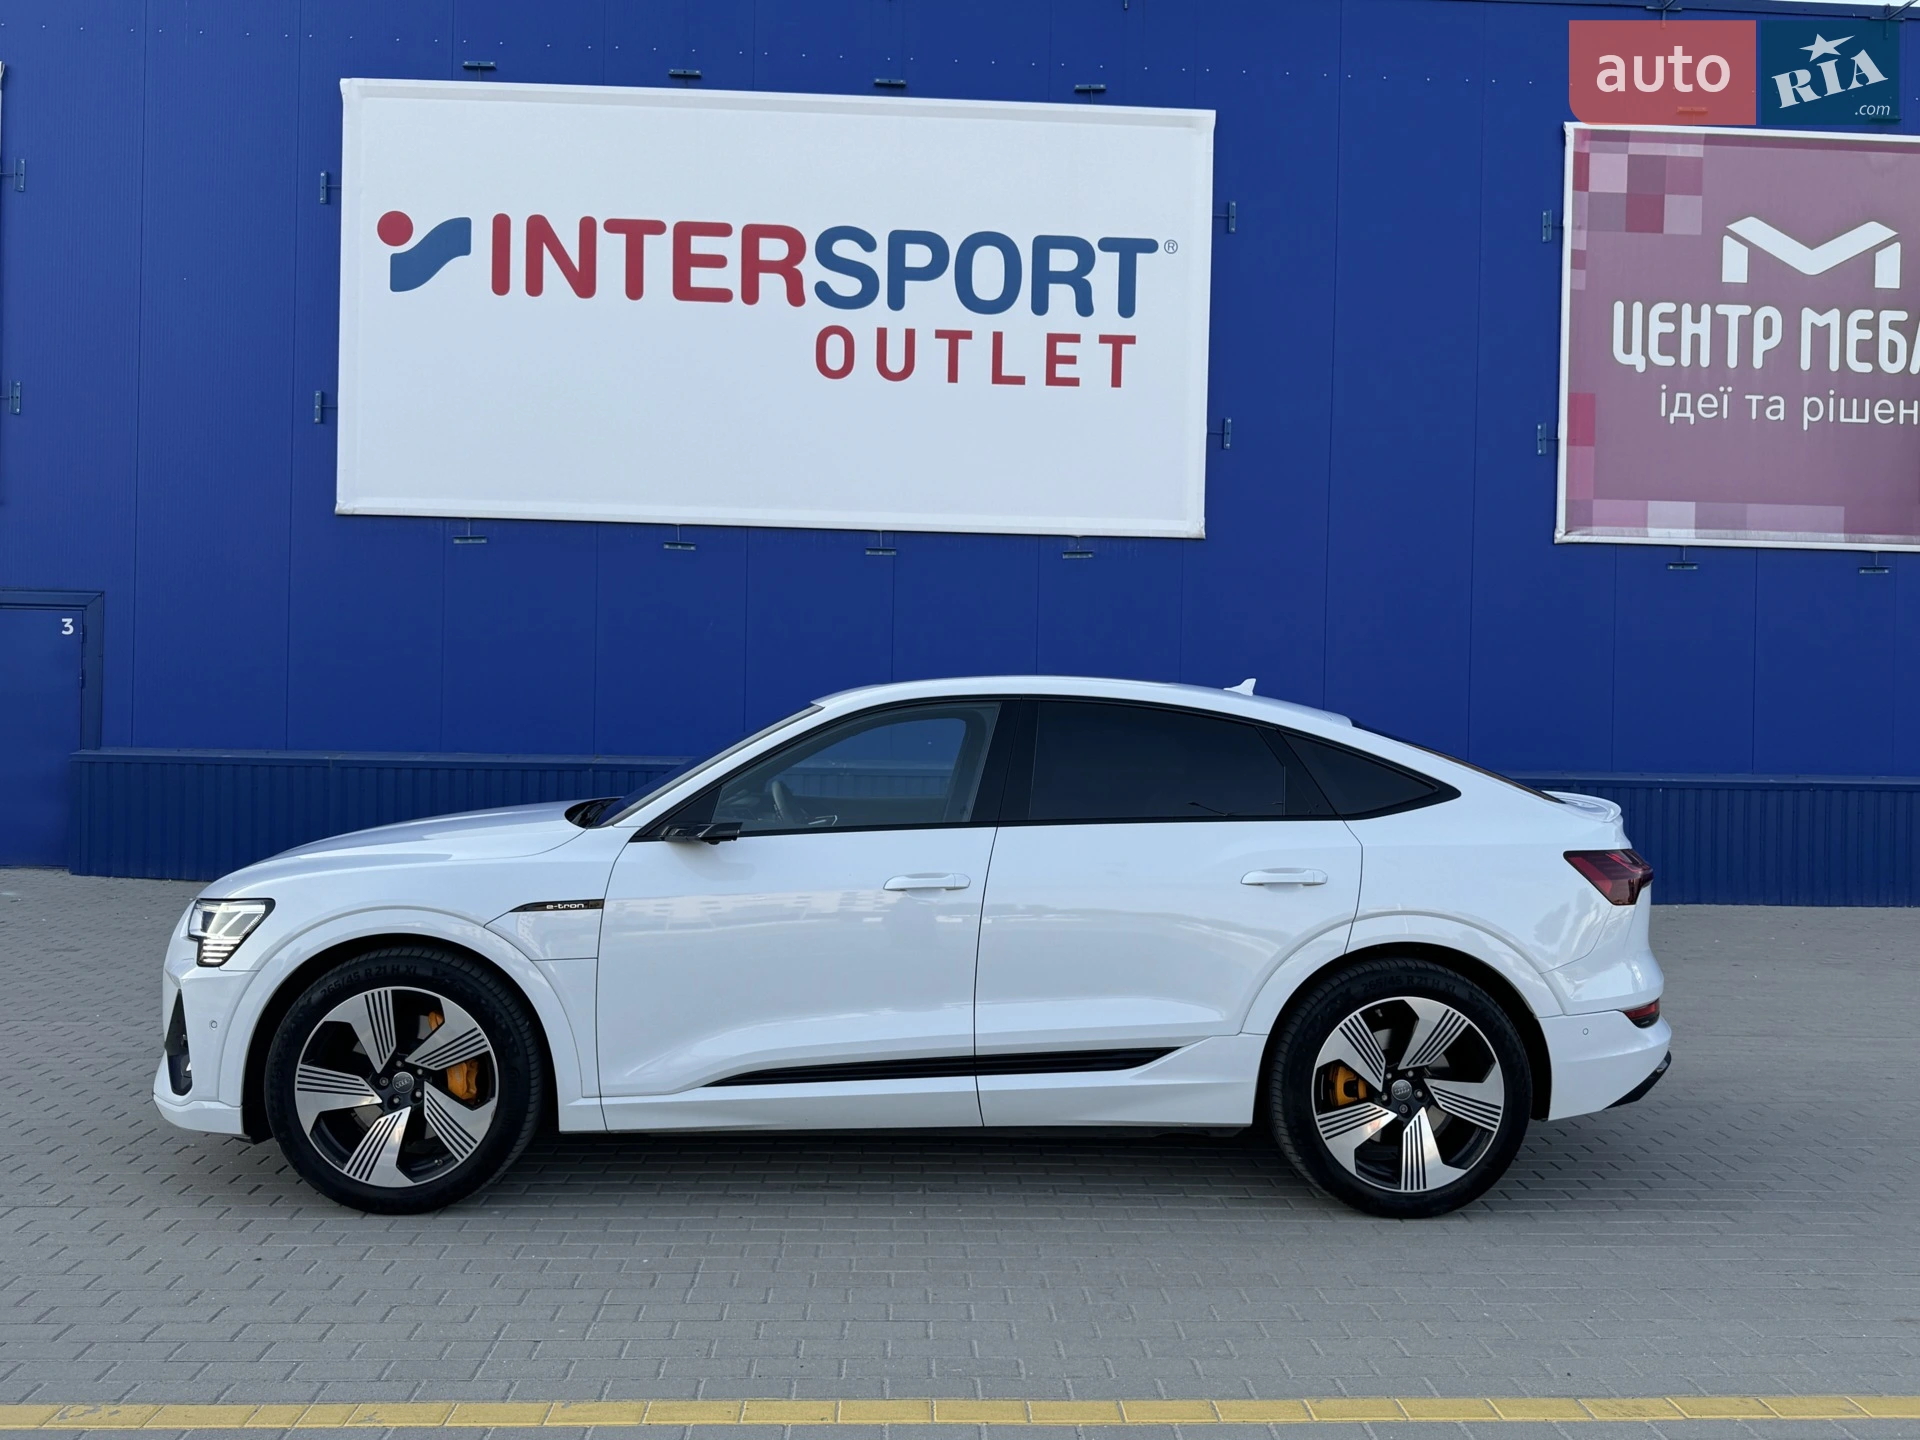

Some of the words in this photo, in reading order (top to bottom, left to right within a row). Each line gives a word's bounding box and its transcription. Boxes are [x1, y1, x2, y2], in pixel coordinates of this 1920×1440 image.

[492, 212, 1159, 319] INTERSPORT
[815, 324, 1137, 388] OUTLET
[1613, 300, 1783, 373] ЦЕНТР
[1660, 383, 1734, 425] ідеї
[1745, 394, 1786, 421] та
[61, 618, 74, 635] 3
